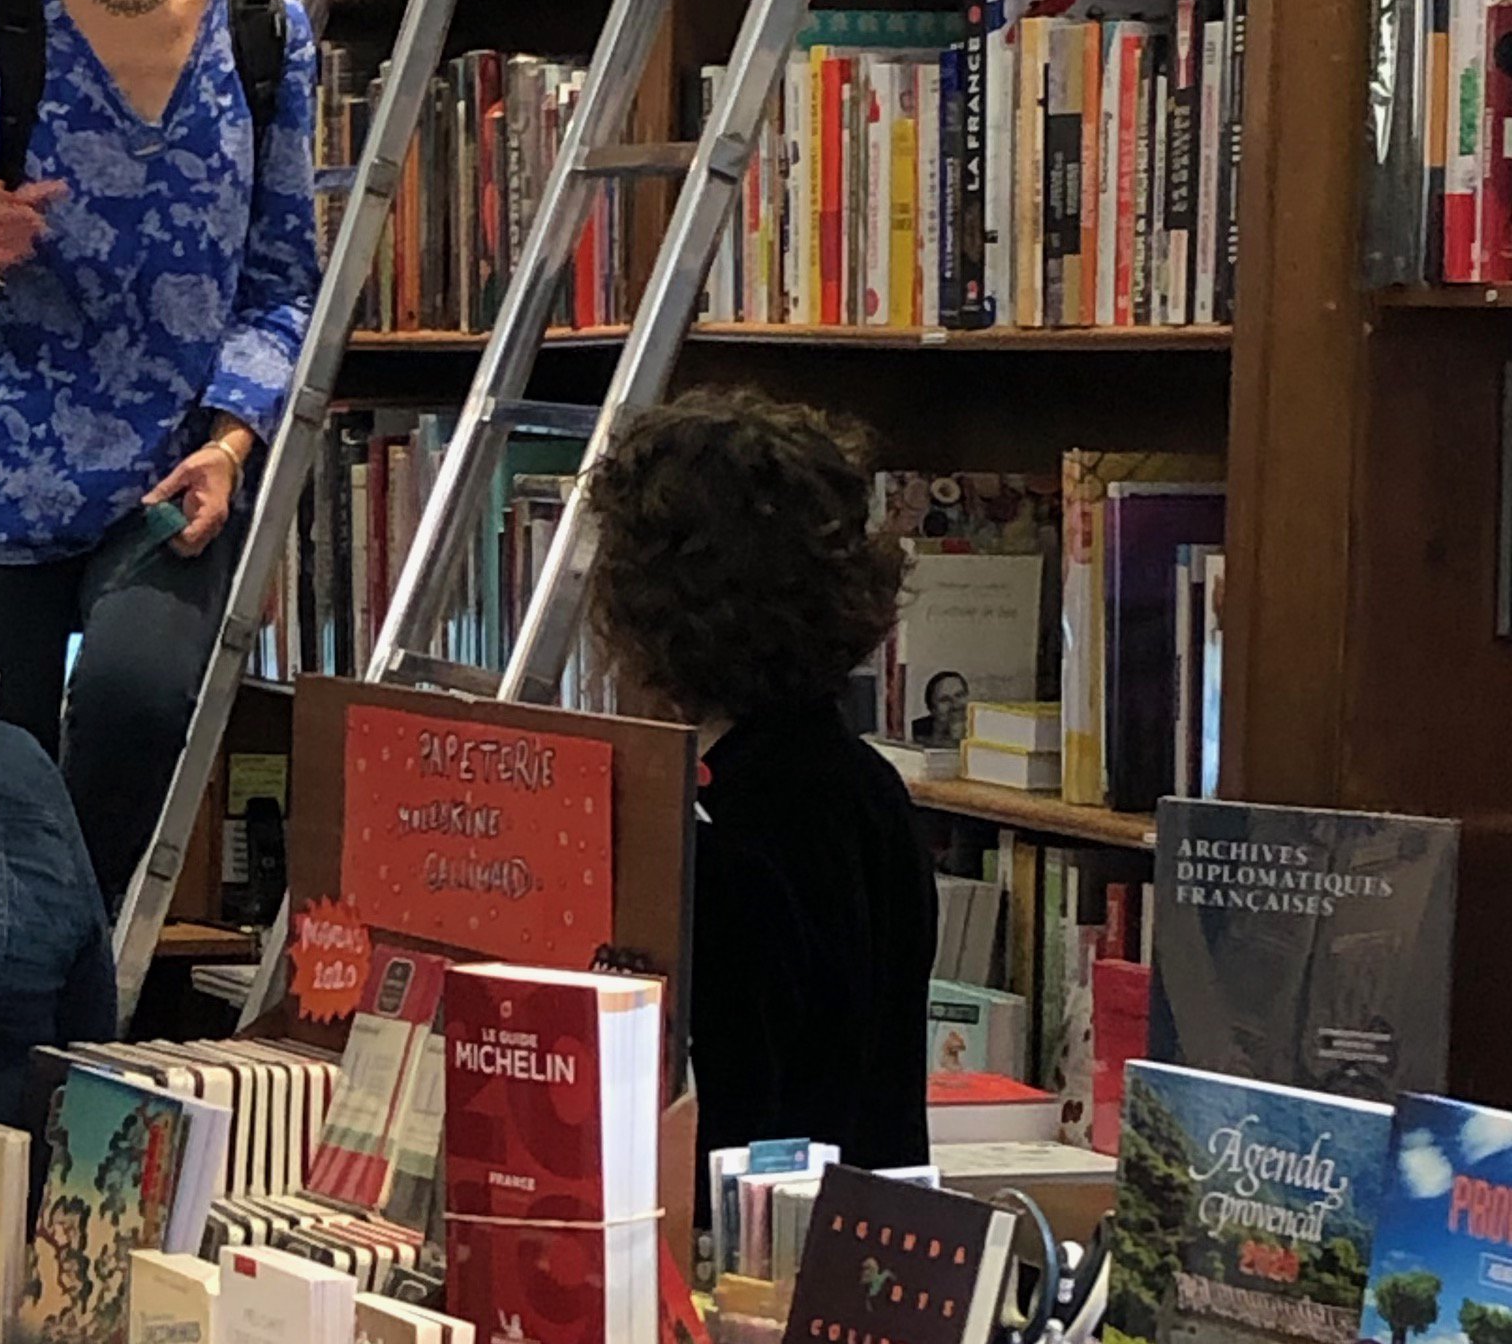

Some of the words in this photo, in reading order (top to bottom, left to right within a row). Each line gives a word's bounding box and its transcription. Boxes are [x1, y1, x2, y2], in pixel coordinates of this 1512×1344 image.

[967, 36, 981, 150] FRANCE
[967, 156, 981, 191] LA
[418, 730, 555, 791] PAPETERIE
[1175, 837, 1309, 866] ARCHIVES
[1175, 860, 1394, 899] DIPLOMATIQUES
[1175, 885, 1336, 917] FRANÇAISES
[498, 1029, 539, 1049] GUIDE
[455, 1040, 576, 1085] MICHELIN
[1188, 1113, 1349, 1209] Agenda
[488, 1170, 536, 1192] FRANCE
[831, 1214, 966, 1265] AGENDA
